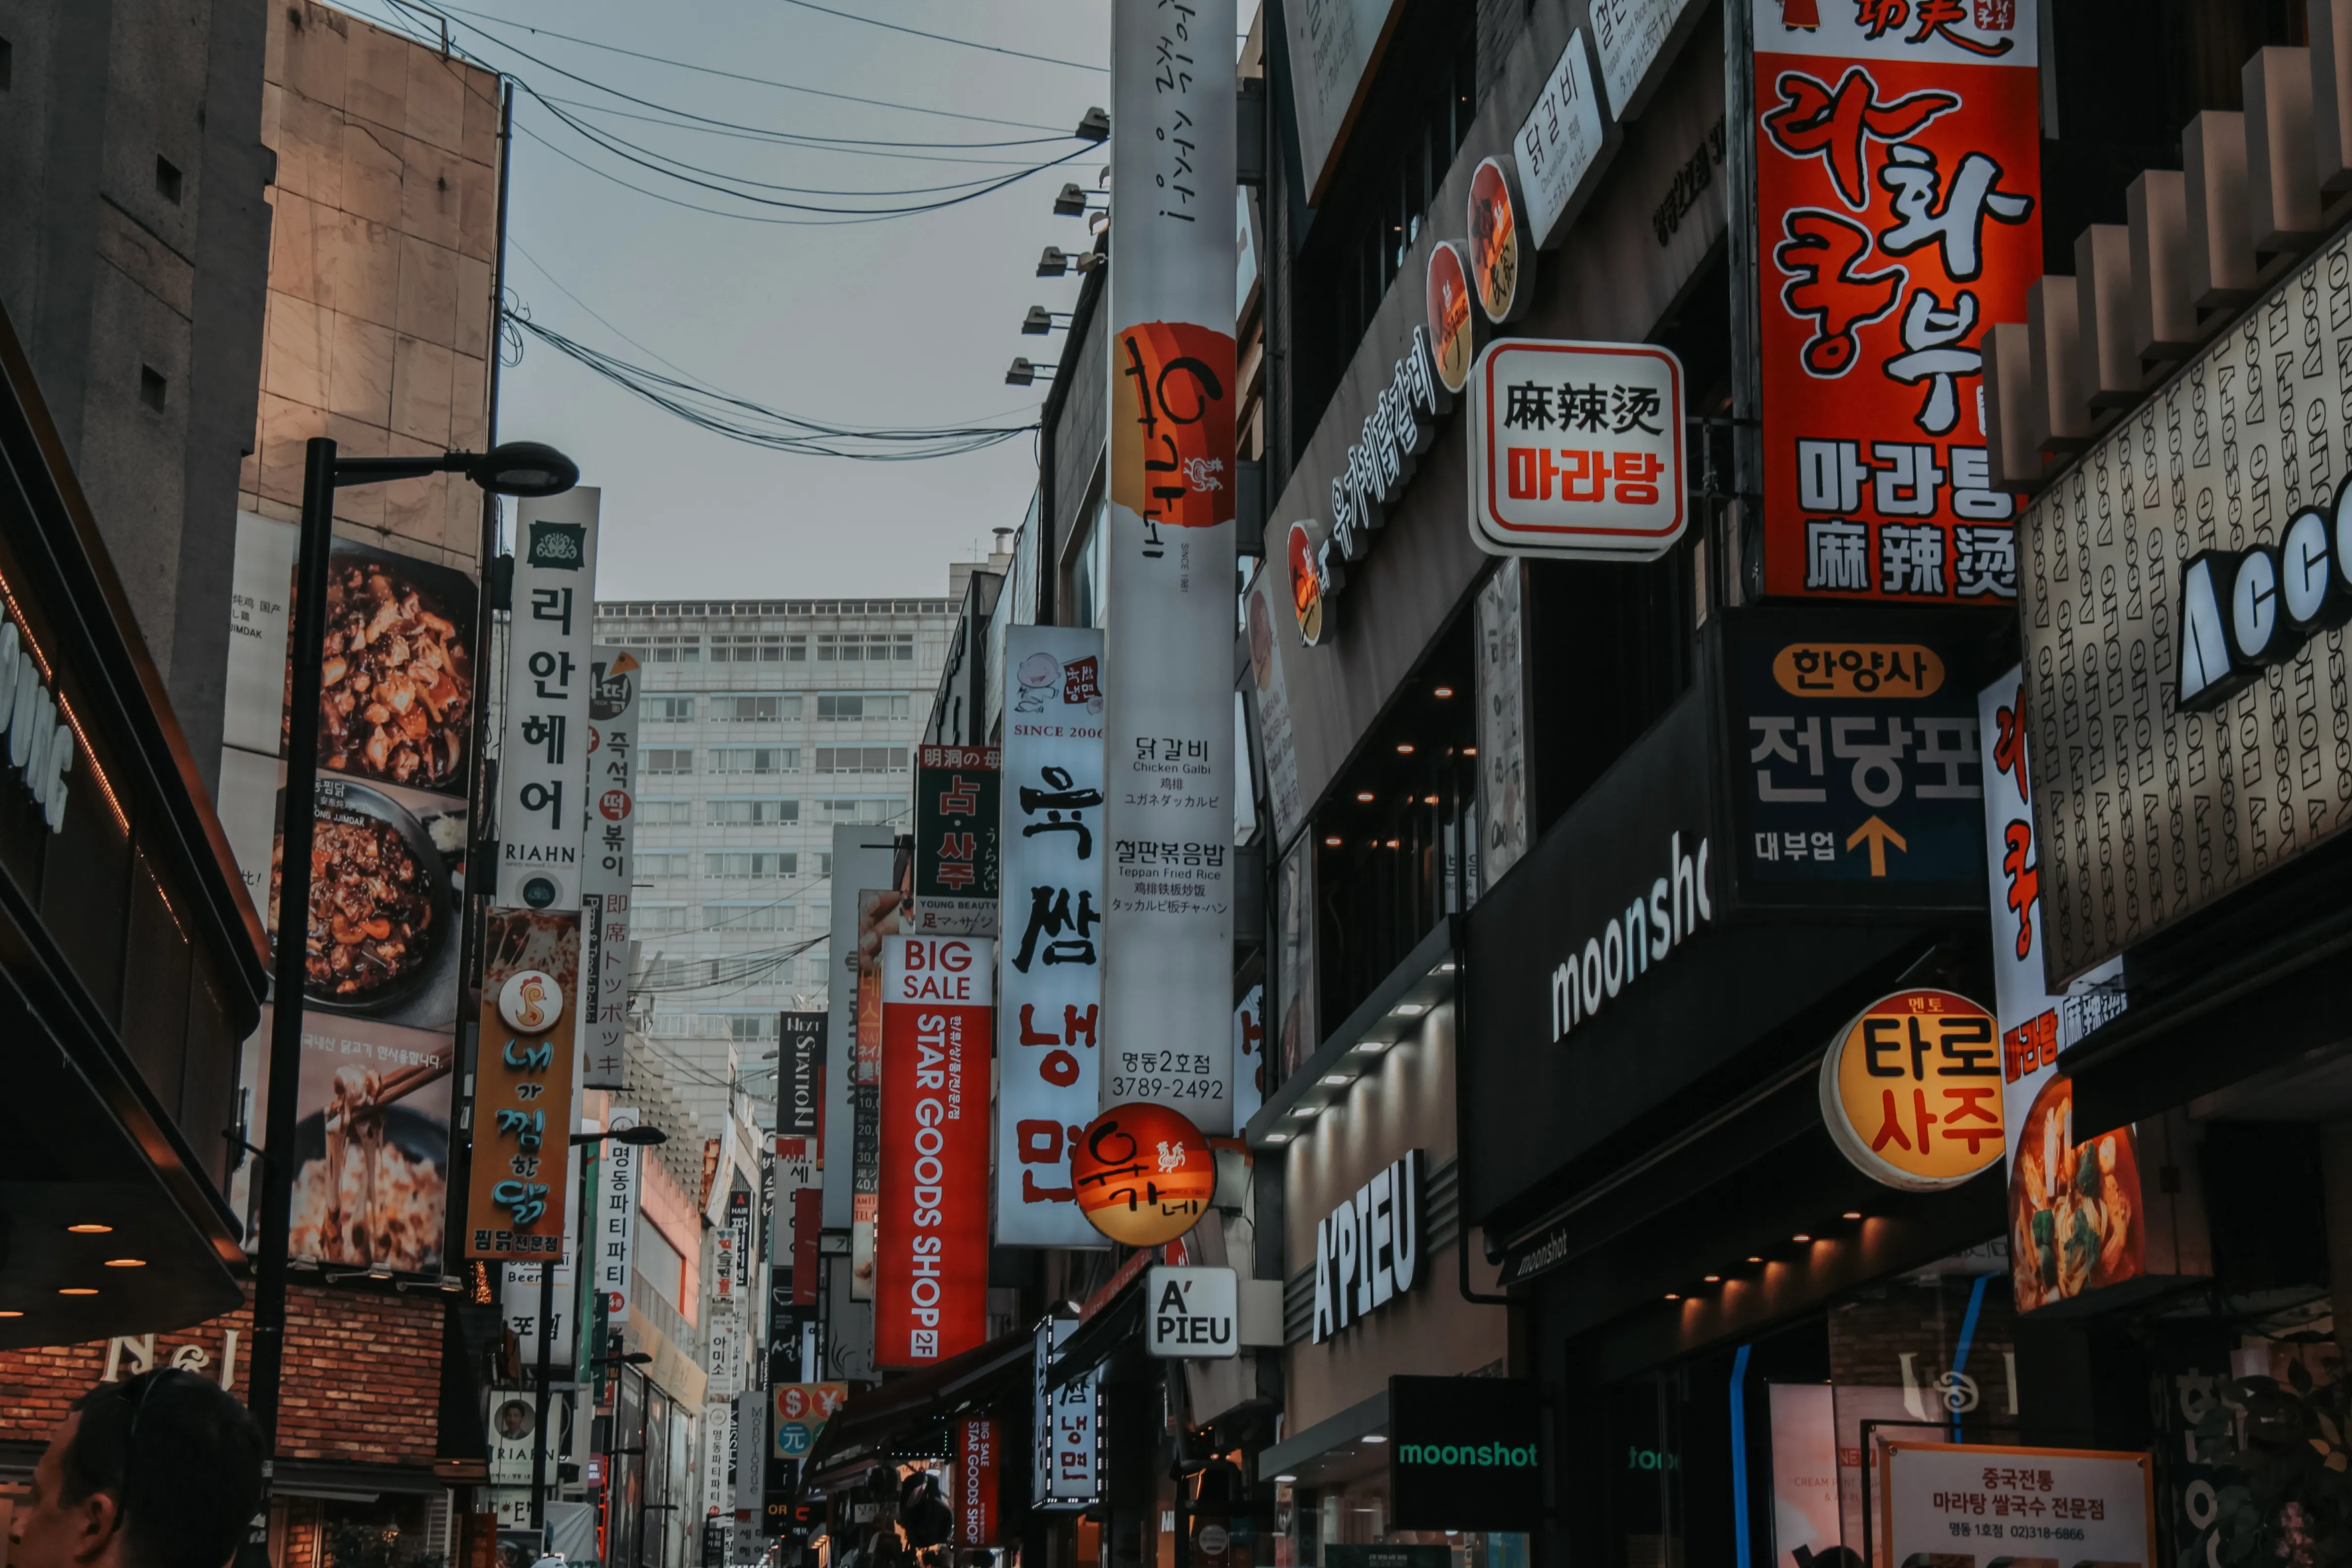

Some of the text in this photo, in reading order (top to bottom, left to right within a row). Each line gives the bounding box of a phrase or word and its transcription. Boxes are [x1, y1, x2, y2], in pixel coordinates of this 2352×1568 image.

[1620, 19, 1635, 51] Fried
[1633, 2, 1648, 28] Rice
[1525, 58, 1579, 177] 닭갈비
[1504, 380, 1664, 436] 麻辣烫
[1331, 323, 1436, 562] 유가네닭갈비
[1507, 447, 1665, 505] 마라탕
[1807, 520, 2017, 597] 麻辣烫
[1792, 648, 1927, 693] 한양사
[521, 588, 576, 830] 리안헤어
[1014, 725, 1064, 737] SINCE
[925, 748, 1001, 769] 明洞の母
[1136, 737, 1208, 762] 닭갈비
[1748, 716, 1982, 807] 전당포
[1133, 761, 1211, 775] Chicken Galbi
[1160, 777, 1184, 791] 鸡排
[602, 732, 630, 878] 즉석떡볶이
[505, 843, 575, 863] RIAHN
[983, 827, 998, 891] うらない
[1115, 839, 1225, 867] 철판볶음밥
[1755, 832, 1835, 861] 대부업
[1119, 866, 1221, 880] Teppan Fried Rice
[920, 900, 954, 909] YOUNG
[922, 912, 993, 929] 足マッサージ
[905, 940, 973, 973] BIG
[597, 894, 627, 1076] 即席トッポッキ
[903, 975, 971, 1001] SALE
[1908, 997, 1944, 1014] 멘토
[340, 1039, 373, 1058] 닭고기
[1122, 1050, 1210, 1075] 명동2호점
[1863, 1016, 2001, 1081] 타로
[2003, 1008, 2058, 1085] 마라탕
[794, 1035, 816, 1127] STATION
[1112, 1076, 1223, 1100] 3789-2492
[1871, 1087, 2005, 1155] 사주
[911, 1013, 946, 1356] STAR GOODS SHOP 2F
[1078, 1120, 1198, 1216] 유가네
[606, 1146, 630, 1286] 명동파티파티
[1312, 1147, 1417, 1345] A'PIEU
[1517, 1227, 1568, 1276] moonshot
[507, 1272, 543, 1283] Beer
[1158, 1280, 1193, 1313] A'
[1157, 1317, 1231, 1344] PIEU
[711, 1336, 727, 1375] 아미소
[749, 1406, 764, 1495] Monologue
[783, 1425, 806, 1451] 元
[980, 1421, 989, 1467] BIG SALE
[1399, 1441, 1538, 1467] moonshot
[711, 1429, 723, 1502] 명동파티파티
[966, 1421, 979, 1545] STAR GOODS SHOP
[1794, 1476, 1829, 1487] CREAM
[1982, 1467, 2055, 1492] 중국전통
[1933, 1491, 2106, 1521] 마라탕 쌀국수 전문점
[1949, 1522, 2085, 1541] 명동 1호점 02)318-6866
